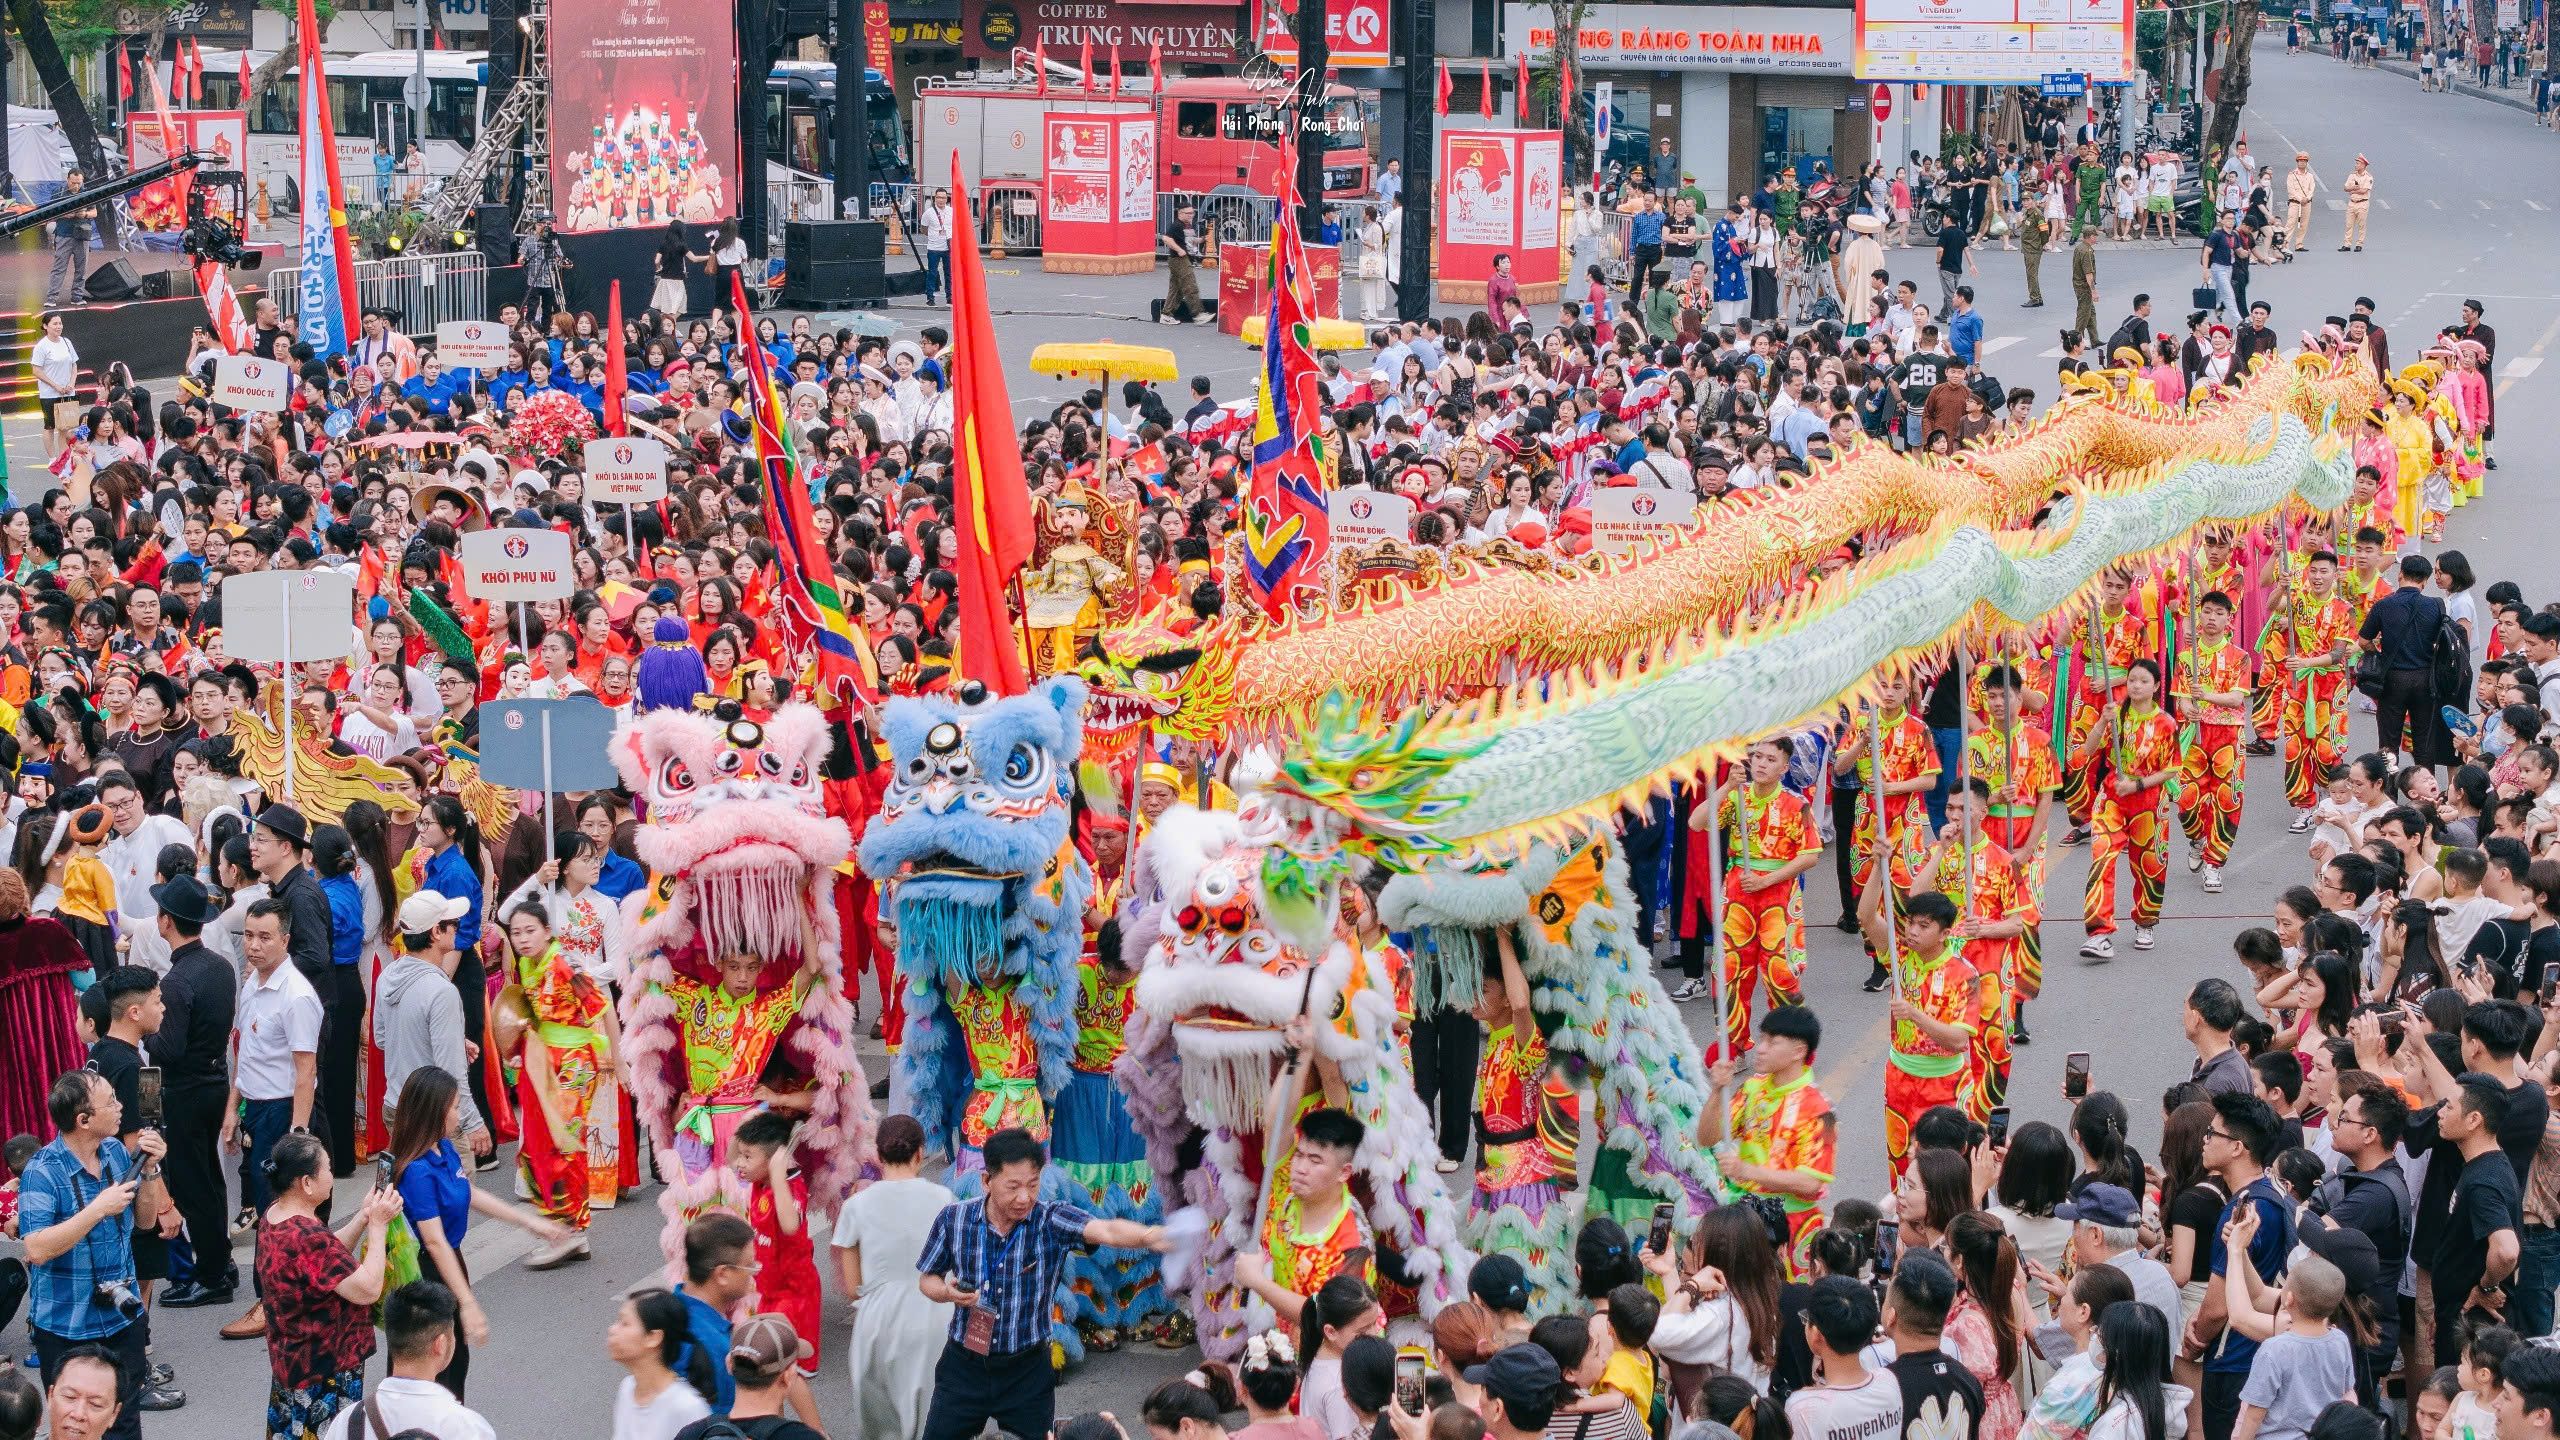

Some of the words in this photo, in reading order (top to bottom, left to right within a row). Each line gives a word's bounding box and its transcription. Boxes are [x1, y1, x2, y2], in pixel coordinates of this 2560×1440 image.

[1038, 4, 1107, 19] COFFEE
[1918, 5, 1962, 14] VINGROUP
[913, 22, 939, 40] Thi
[1039, 25, 1123, 46] TRUNG
[1131, 22, 1236, 48] NGUYÊN
[1529, 28, 1613, 50] PHNG
[1621, 25, 1691, 51] RĂNG
[1620, 54, 1647, 62] CHUYÊN
[1491, 197, 1508, 205] 19-5
[1909, 363, 1937, 386] 26
[227, 384, 245, 395] KHỐI
[246, 386, 266, 397] QUỐC
[595, 471, 611, 480] KHỐI
[610, 483, 624, 493] VIỆT
[626, 484, 643, 494] PHỤC
[1595, 522, 1608, 530] CLB
[303, 577, 316, 587] 03
[481, 568, 510, 584] KHỐI
[513, 571, 537, 585] PHỤ
[540, 569, 557, 583] NỮ
[508, 714, 521, 725] 02
[1541, 896, 1562, 921] VIỆT
[1828, 1407, 1901, 1440] nguyenkho
